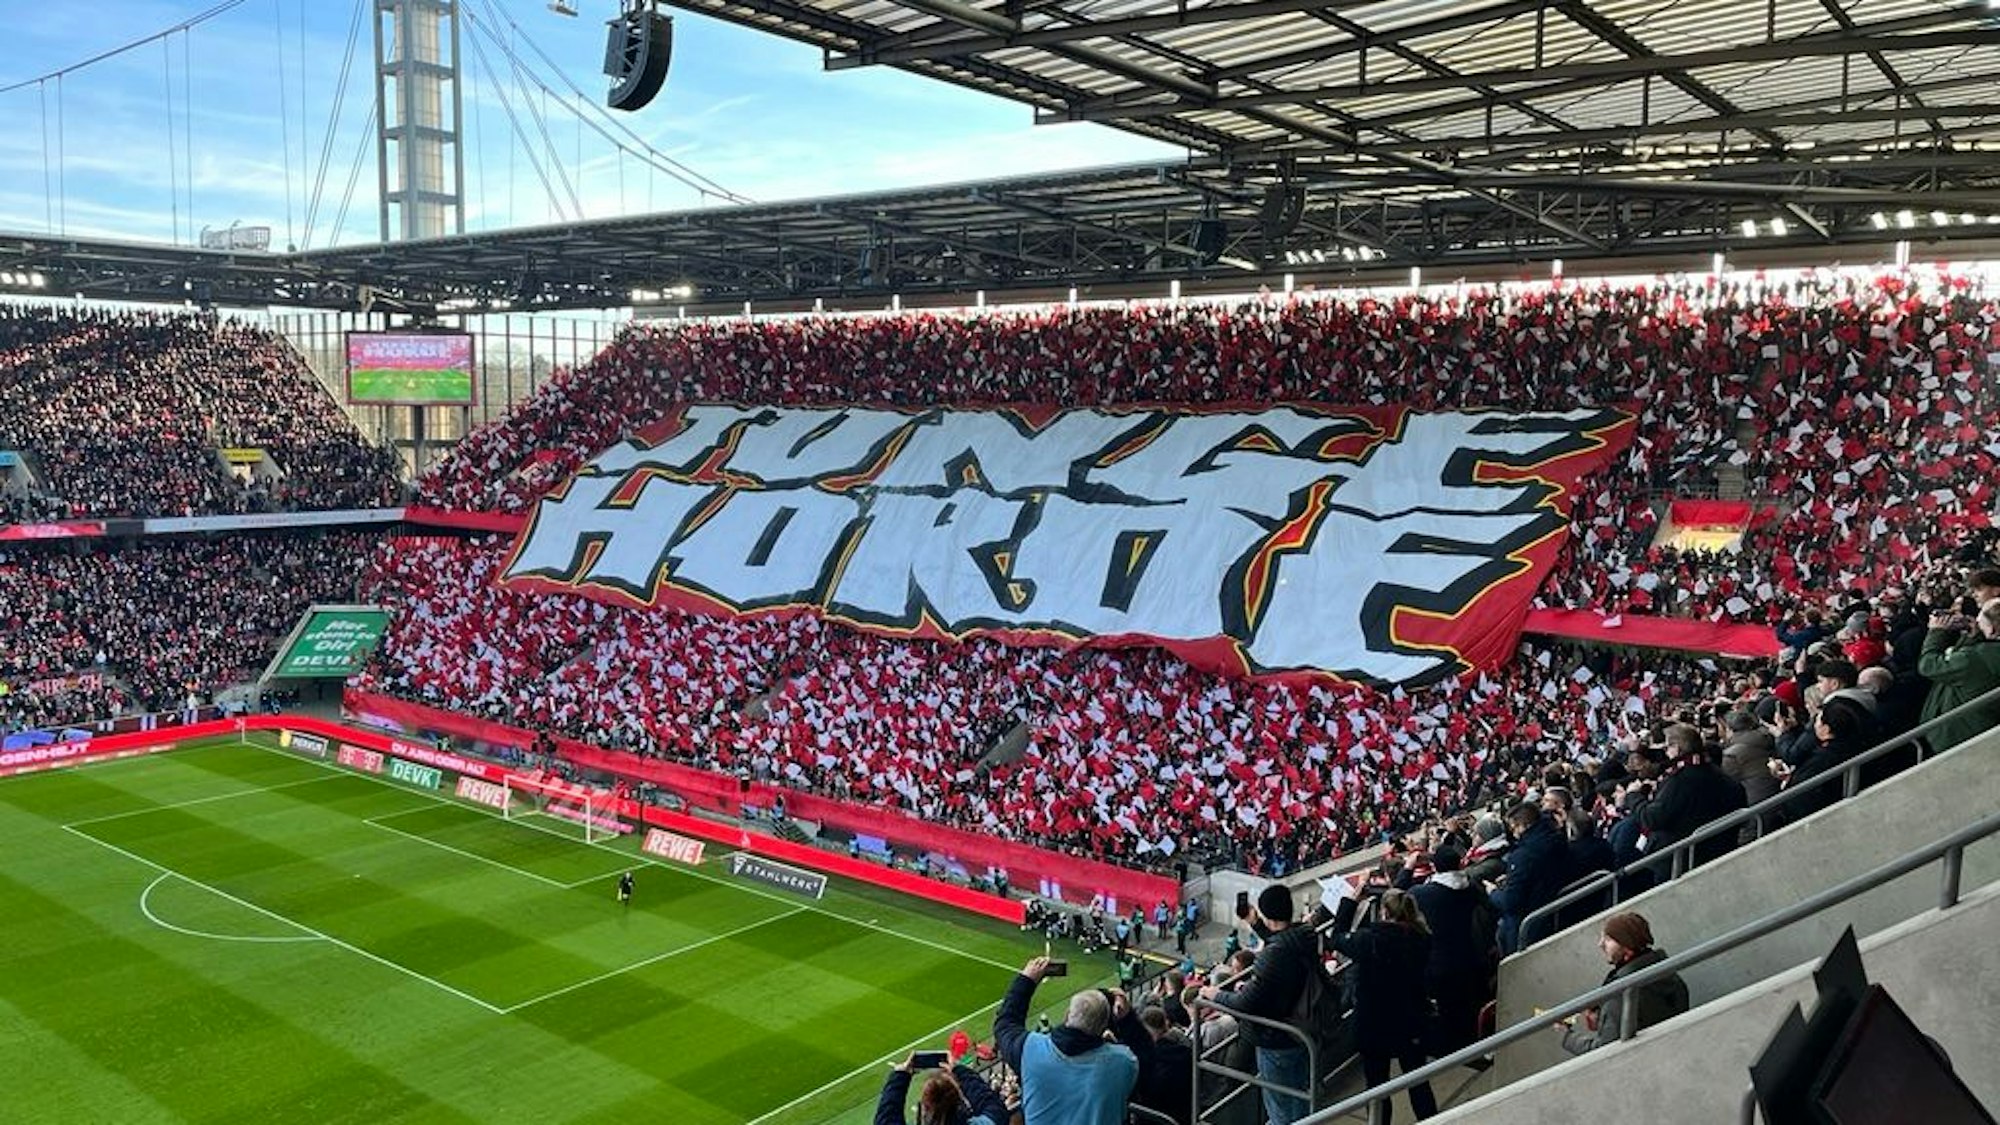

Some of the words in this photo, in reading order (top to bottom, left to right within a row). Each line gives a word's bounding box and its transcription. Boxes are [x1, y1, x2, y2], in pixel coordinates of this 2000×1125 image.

[590, 402, 1612, 512] JUNGE
[500, 468, 1552, 685] HORDE
[392, 761, 434, 788] DEVK
[460, 778, 503, 807] REWE
[648, 831, 696, 862] REWE
